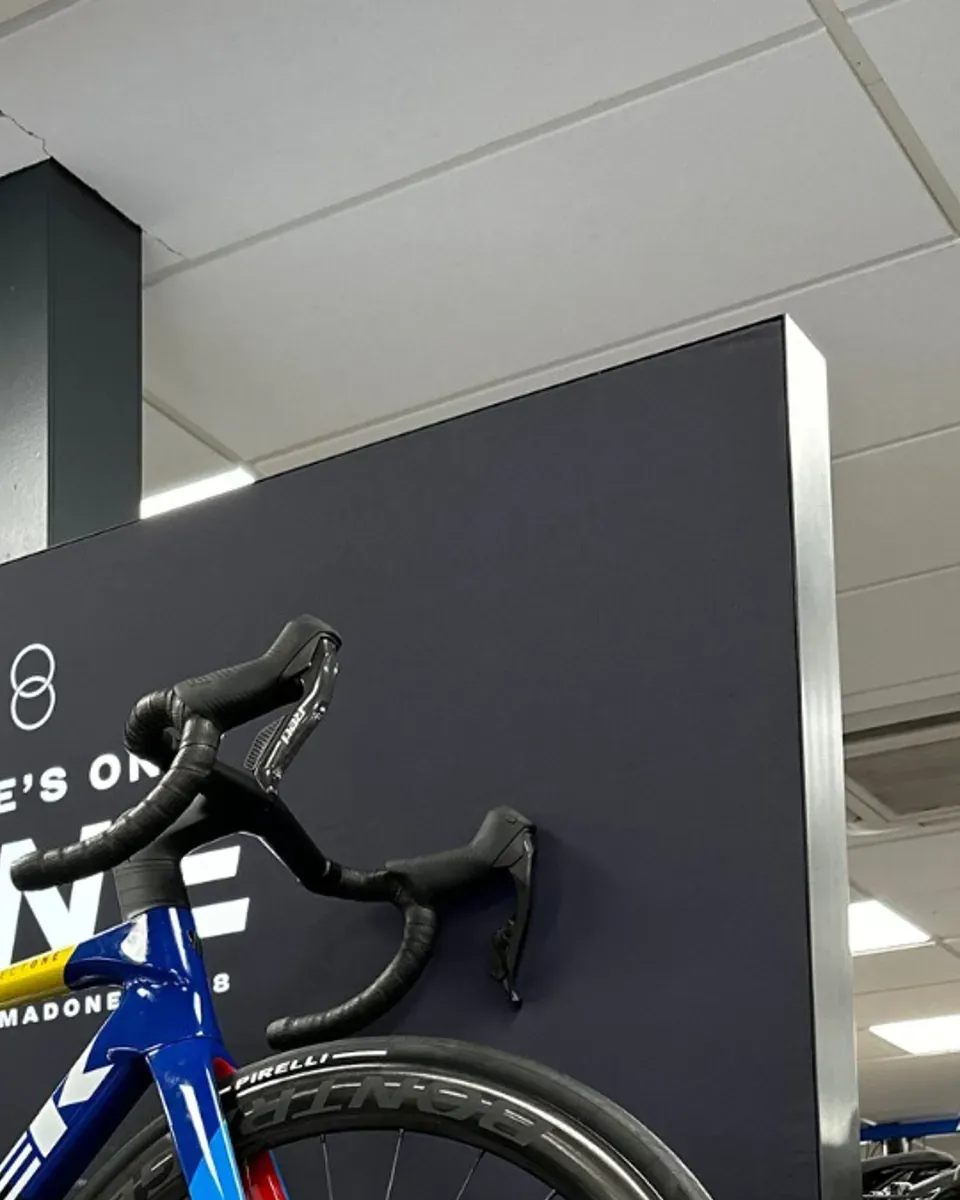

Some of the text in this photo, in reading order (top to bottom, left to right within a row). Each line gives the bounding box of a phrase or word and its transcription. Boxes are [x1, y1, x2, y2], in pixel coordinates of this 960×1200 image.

[89, 753, 161, 791] ON
[212, 972, 230, 994] 8
[234, 1052, 330, 1091] PIRELLI
